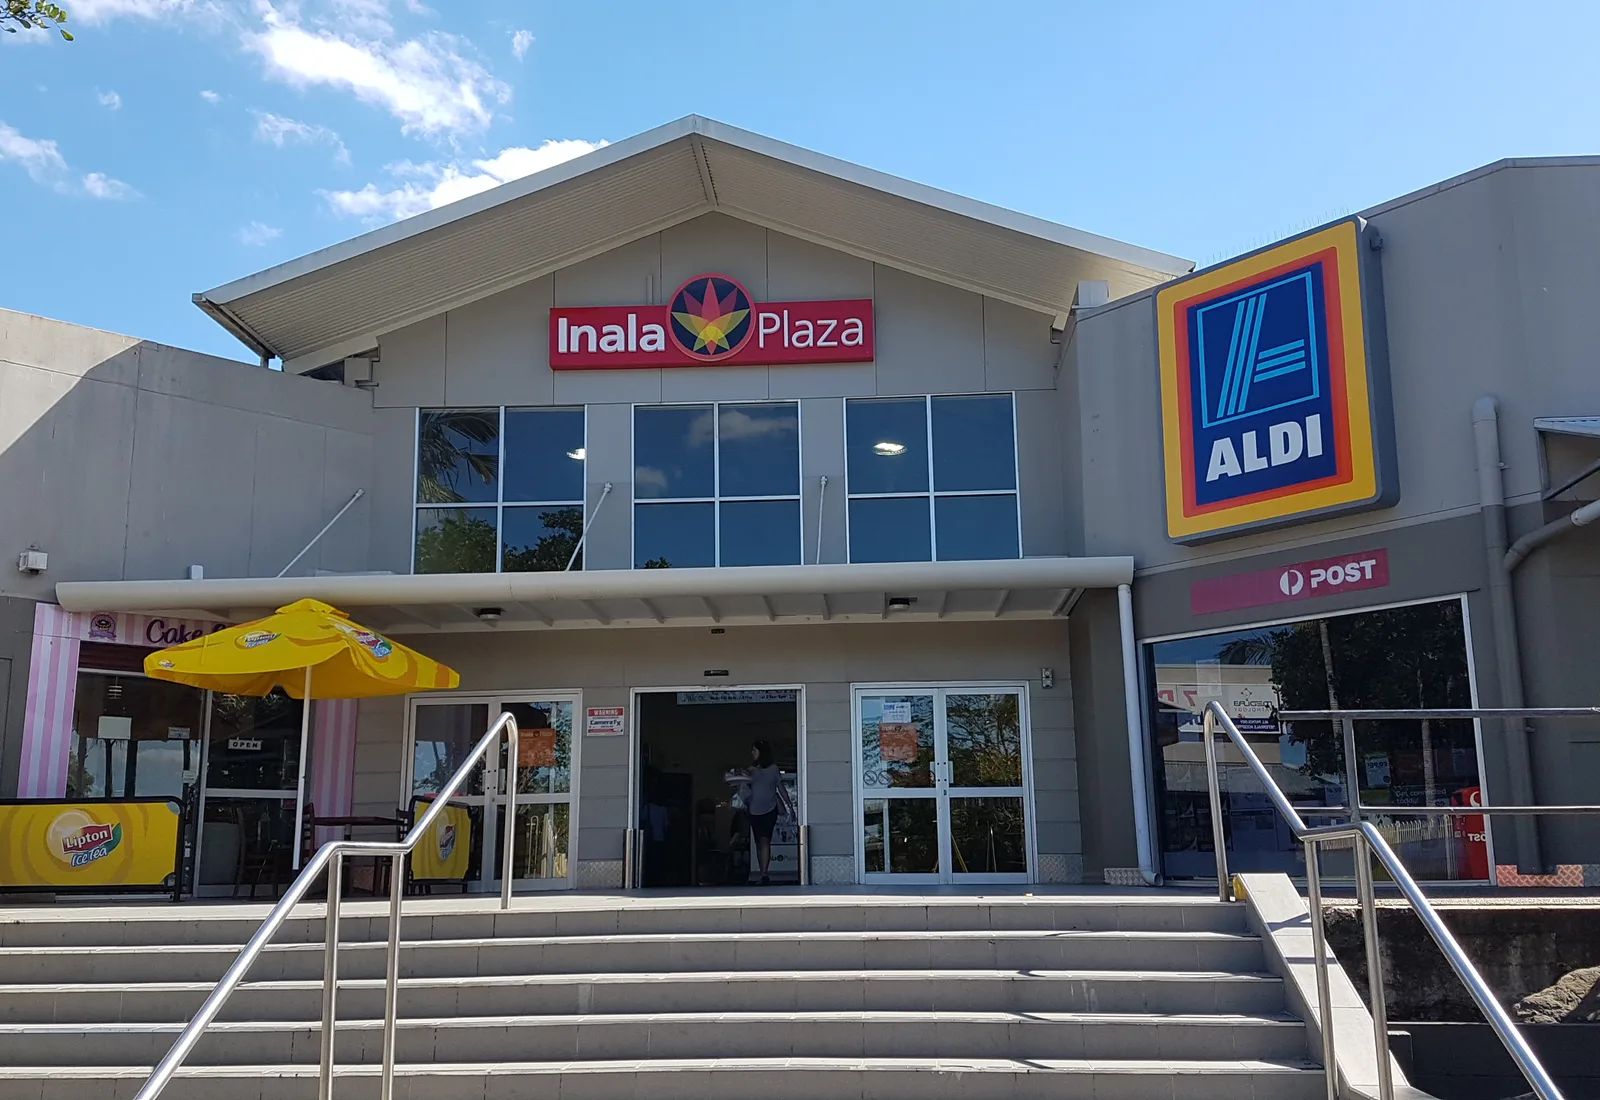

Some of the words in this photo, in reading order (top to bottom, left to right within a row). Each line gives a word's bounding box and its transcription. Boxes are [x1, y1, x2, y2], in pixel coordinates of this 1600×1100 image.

[558, 313, 666, 354] Inala
[758, 310, 864, 349] Plaza
[1205, 413, 1323, 483] ALDI
[1310, 559, 1377, 588] POST
[146, 619, 203, 644] Cake
[65, 829, 108, 849] Lipton
[71, 853, 88, 867] Ice
[89, 847, 108, 861] Tea
